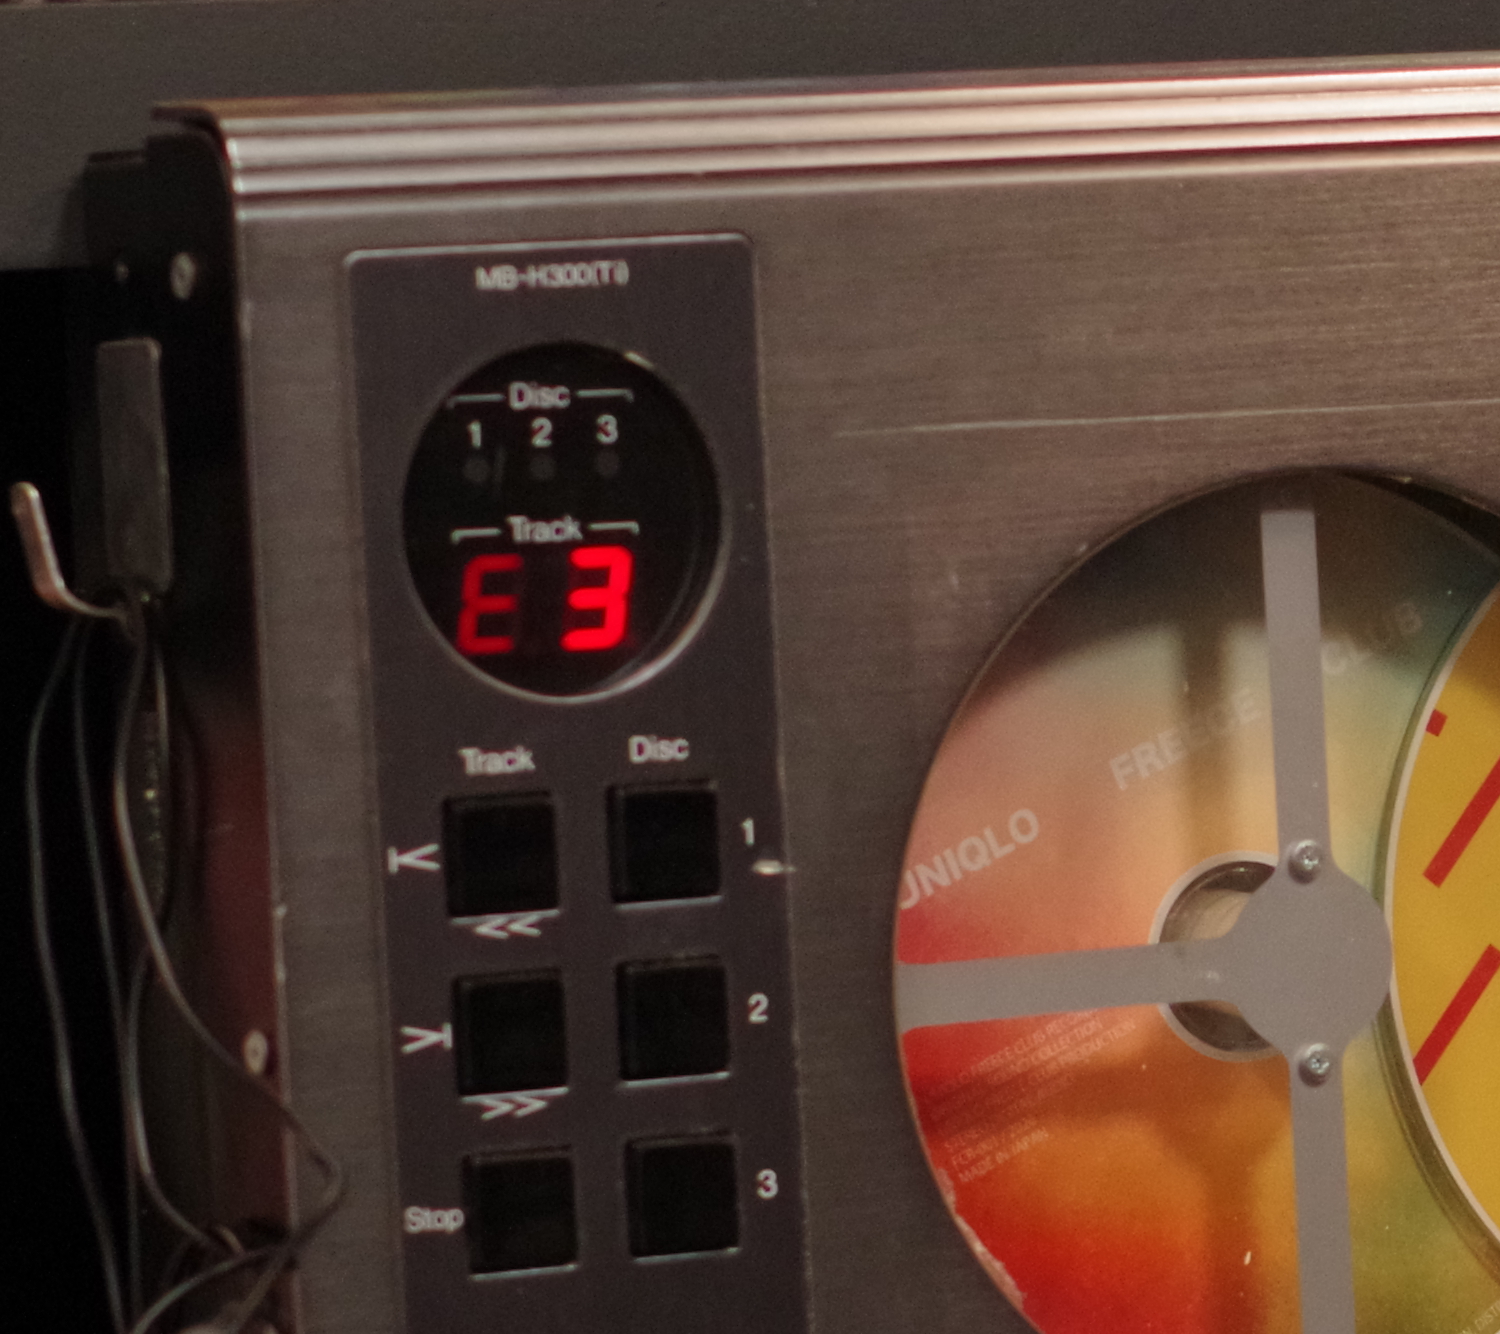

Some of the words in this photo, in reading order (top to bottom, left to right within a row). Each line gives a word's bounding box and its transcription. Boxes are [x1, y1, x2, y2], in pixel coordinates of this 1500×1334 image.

[508, 382, 572, 410] Disc
[467, 421, 482, 449] 1
[531, 418, 553, 448] 2
[596, 414, 619, 445] 3
[506, 514, 584, 543] Track
[458, 746, 537, 776] Track
[627, 734, 691, 764] Disc
[741, 817, 756, 847] 1
[748, 992, 770, 1024] 2
[756, 1169, 780, 1200] 3
[404, 1205, 466, 1234] Stop
